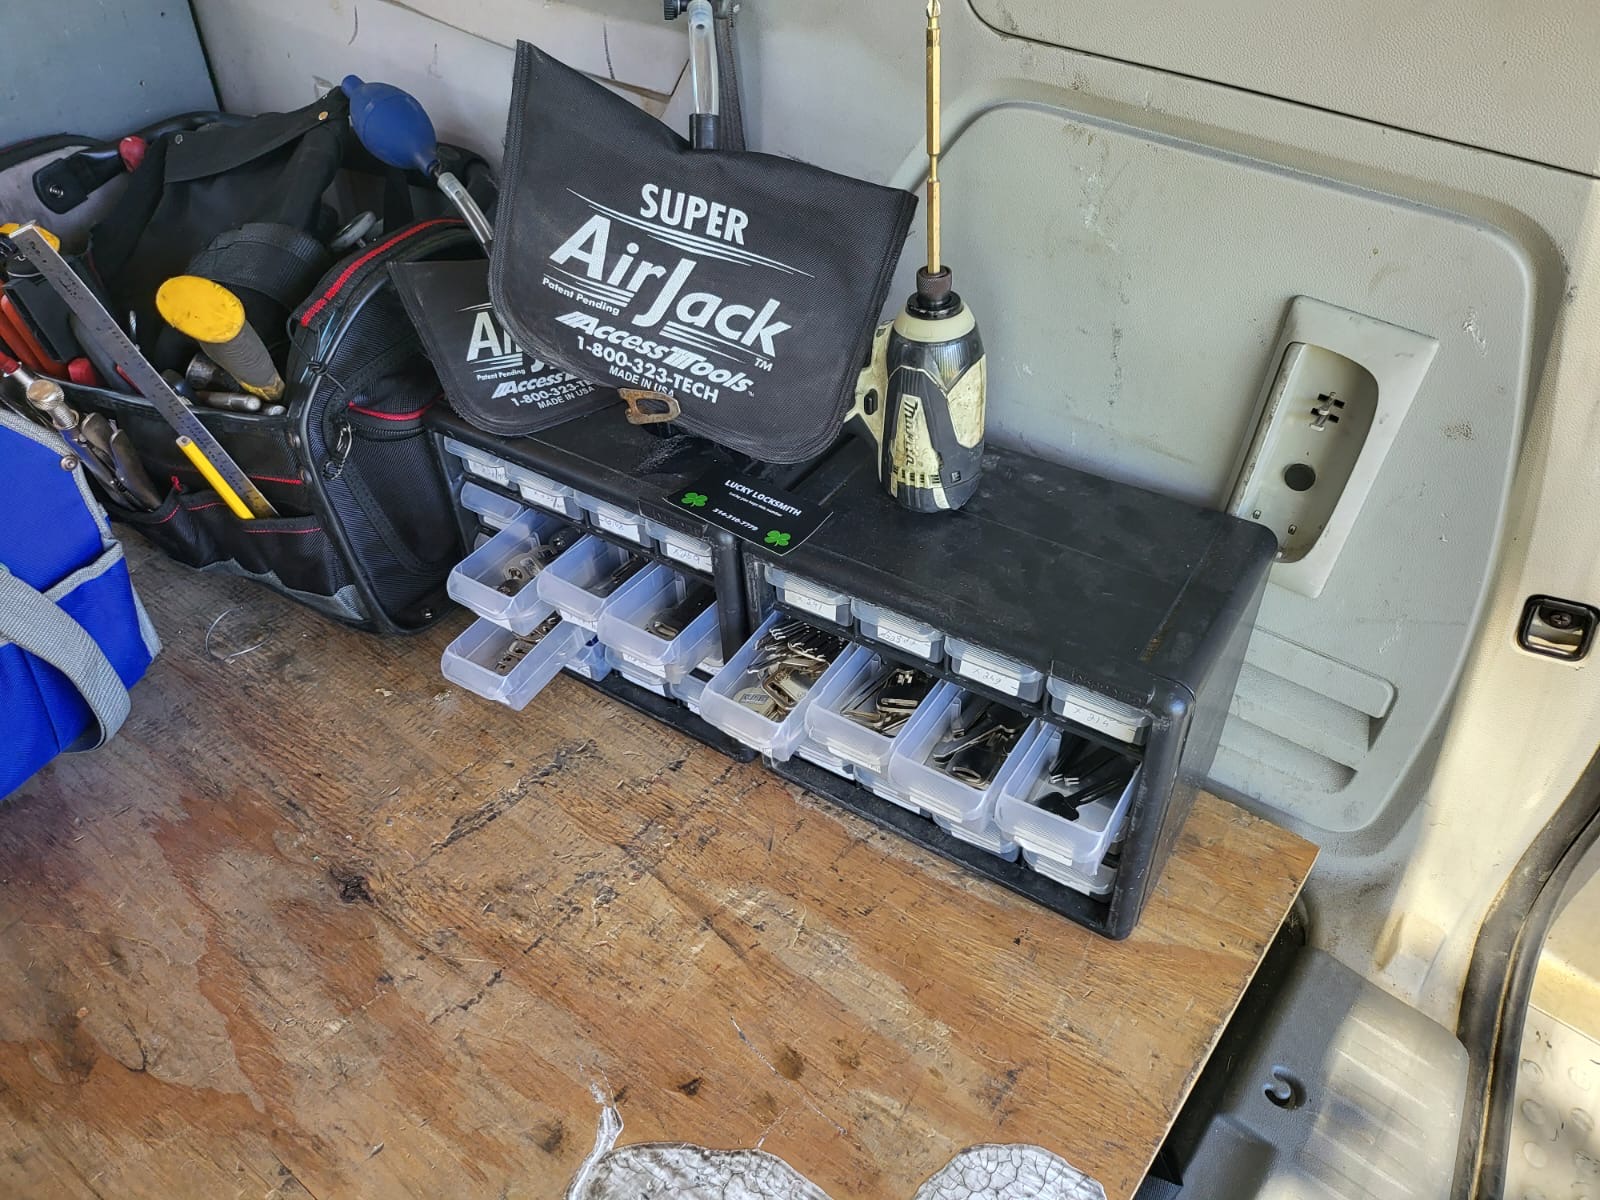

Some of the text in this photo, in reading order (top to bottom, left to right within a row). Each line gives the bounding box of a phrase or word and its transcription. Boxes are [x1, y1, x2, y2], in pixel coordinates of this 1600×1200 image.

[640, 183, 749, 246] SUPER
[542, 277, 621, 316] Patent Pending
[477, 369, 526, 381] Patent Pending
[577, 336, 719, 403] 1-800-323-TECH
[609, 365, 675, 398] MADE IN USA
[511, 380, 593, 407] 1-800-323-TE
[536, 386, 595, 409] MADE IN USA
[724, 480, 802, 516] LUCKY LOCKSMITH
